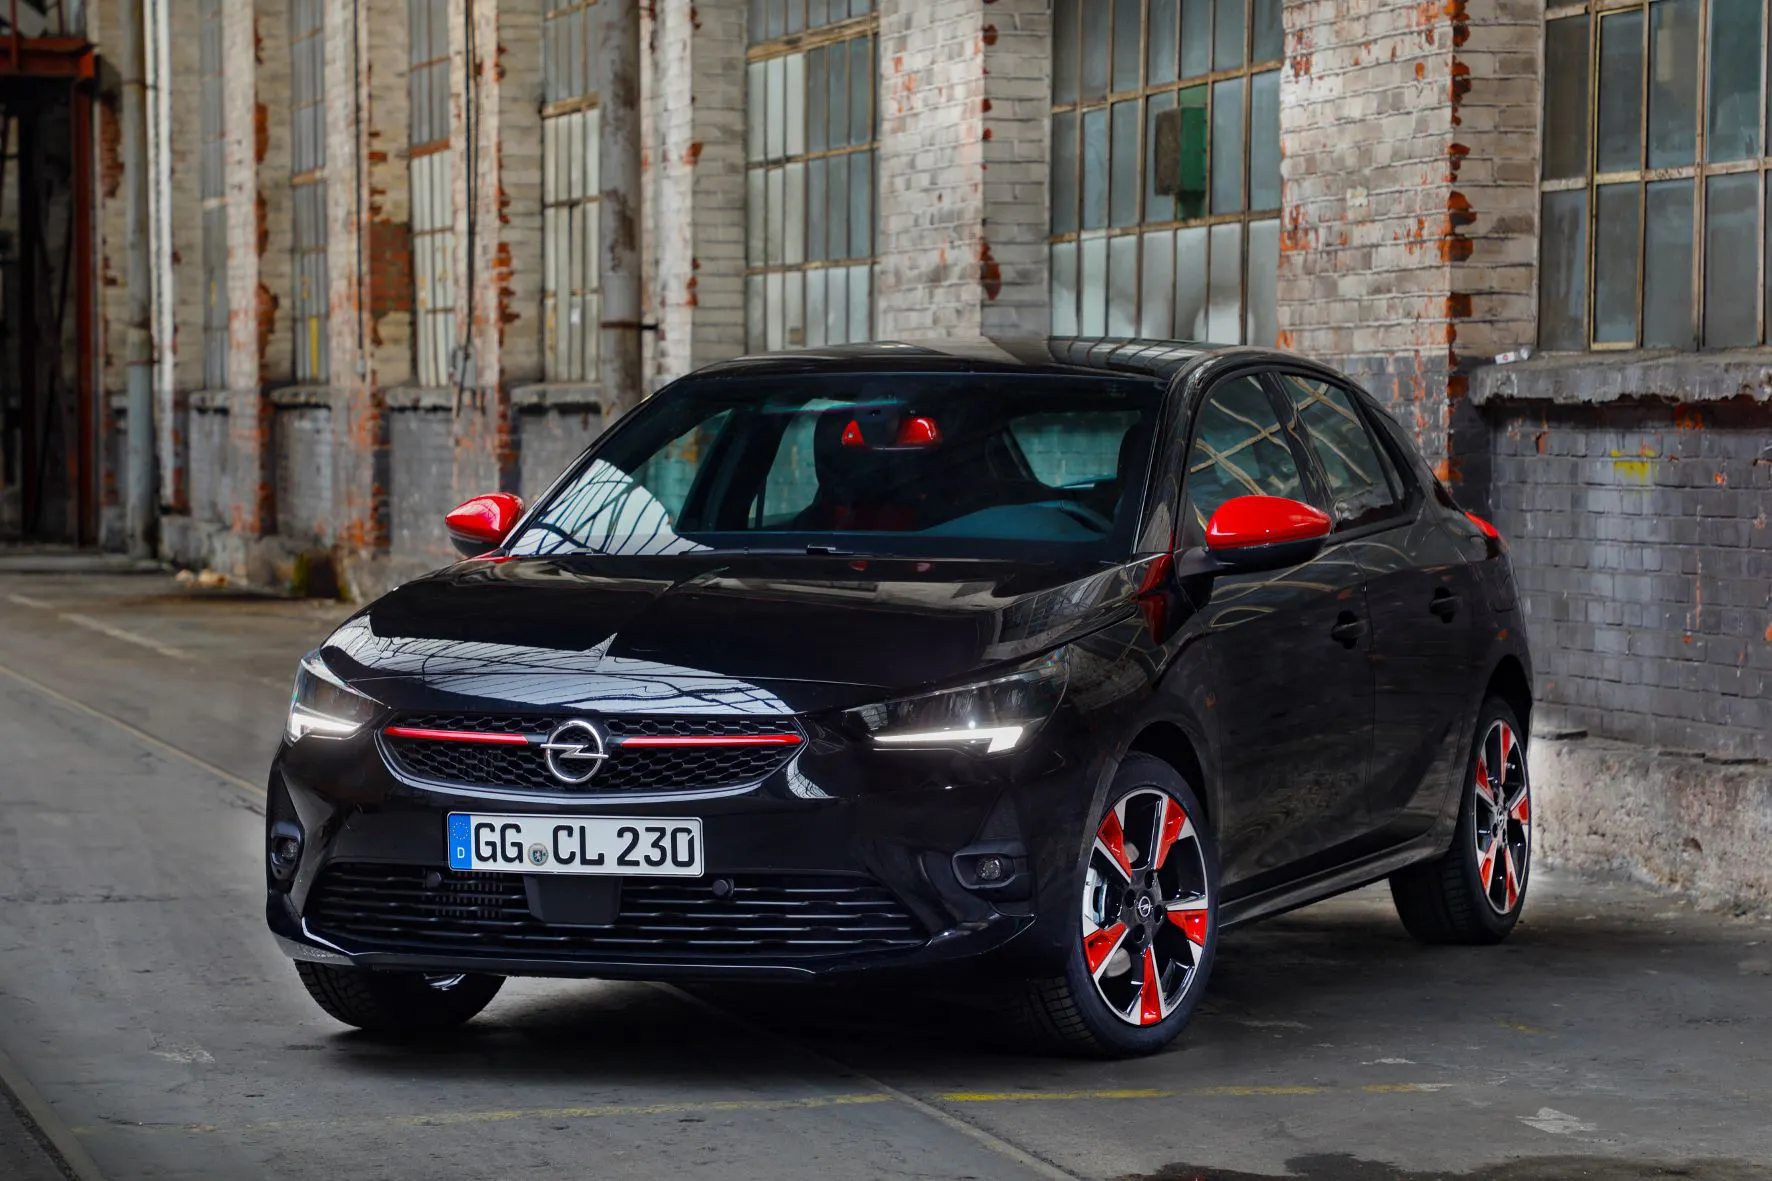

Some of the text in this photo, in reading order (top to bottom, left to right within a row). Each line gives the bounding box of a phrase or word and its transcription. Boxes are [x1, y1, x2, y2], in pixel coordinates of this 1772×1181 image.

[457, 846, 465, 858] D
[474, 822, 695, 868] GG CL 230
